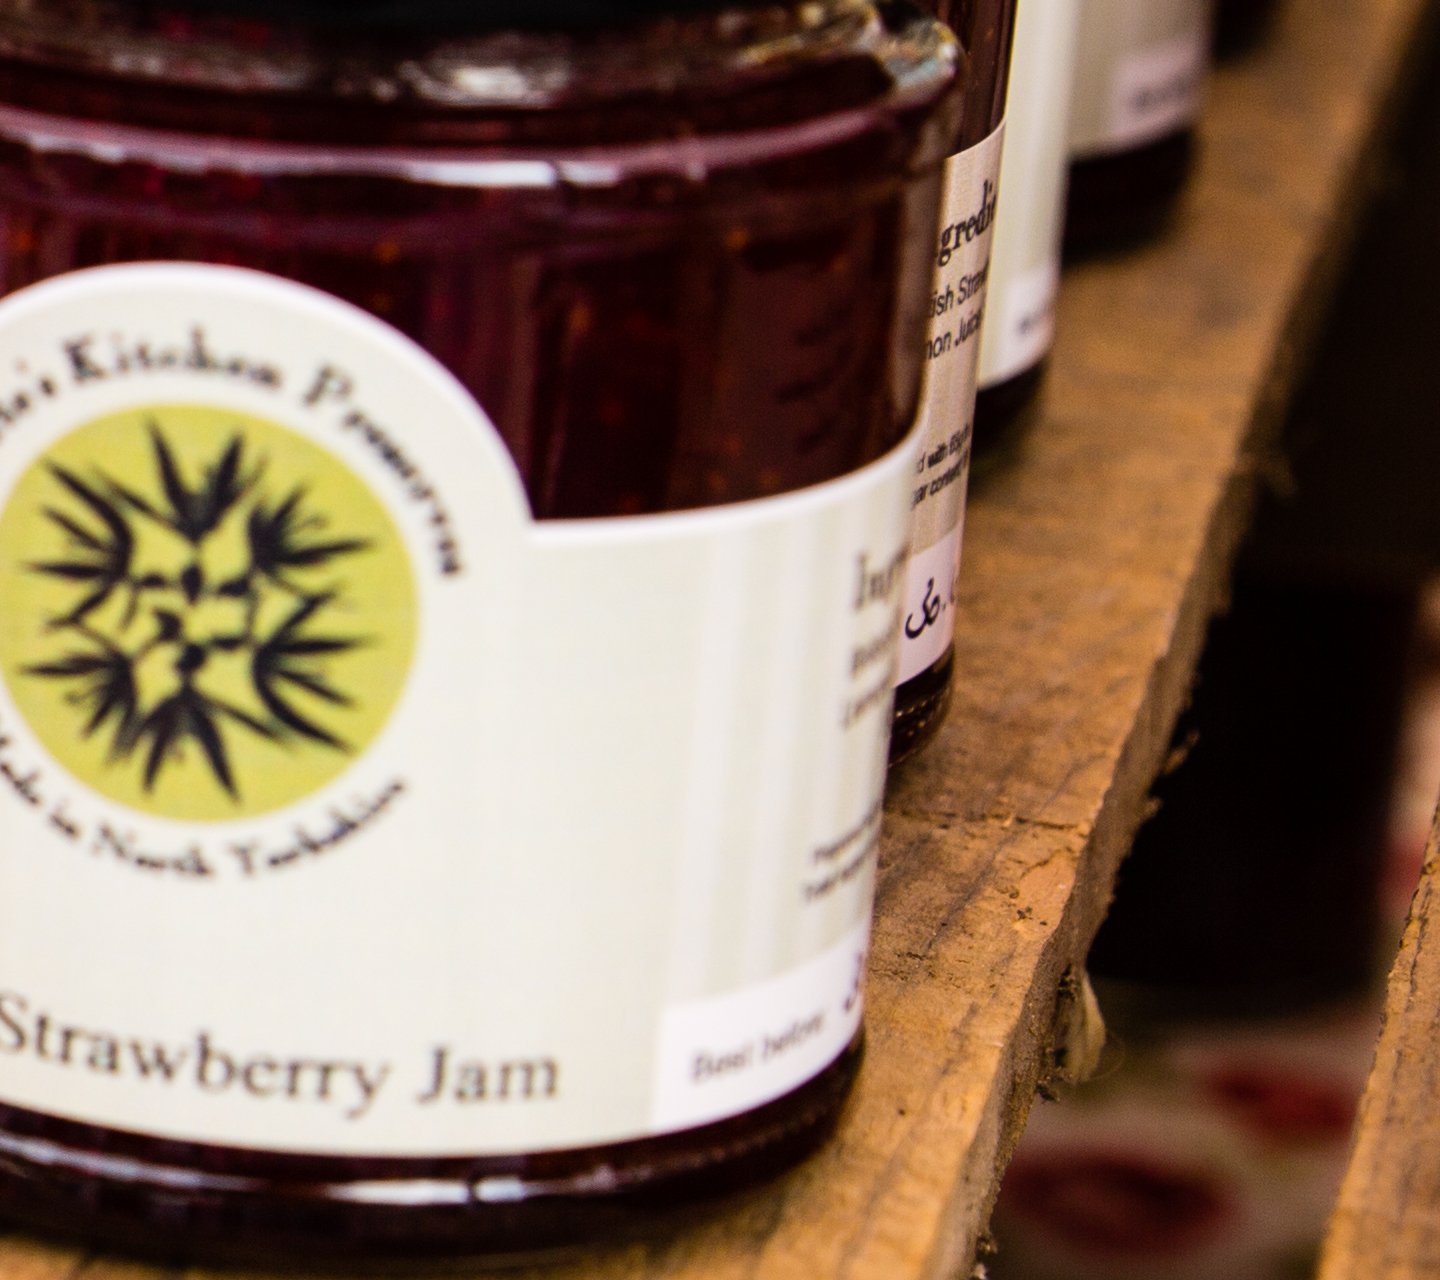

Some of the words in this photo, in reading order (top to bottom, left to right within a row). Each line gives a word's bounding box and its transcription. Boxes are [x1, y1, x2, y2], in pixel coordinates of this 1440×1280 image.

[61, 325, 284, 391] Kitchen
[304, 364, 467, 579] Preserves
[47, 805, 81, 842] in
[91, 823, 215, 881] North
[230, 776, 409, 879] Yorkshire
[415, 1044, 562, 1107] Jam
